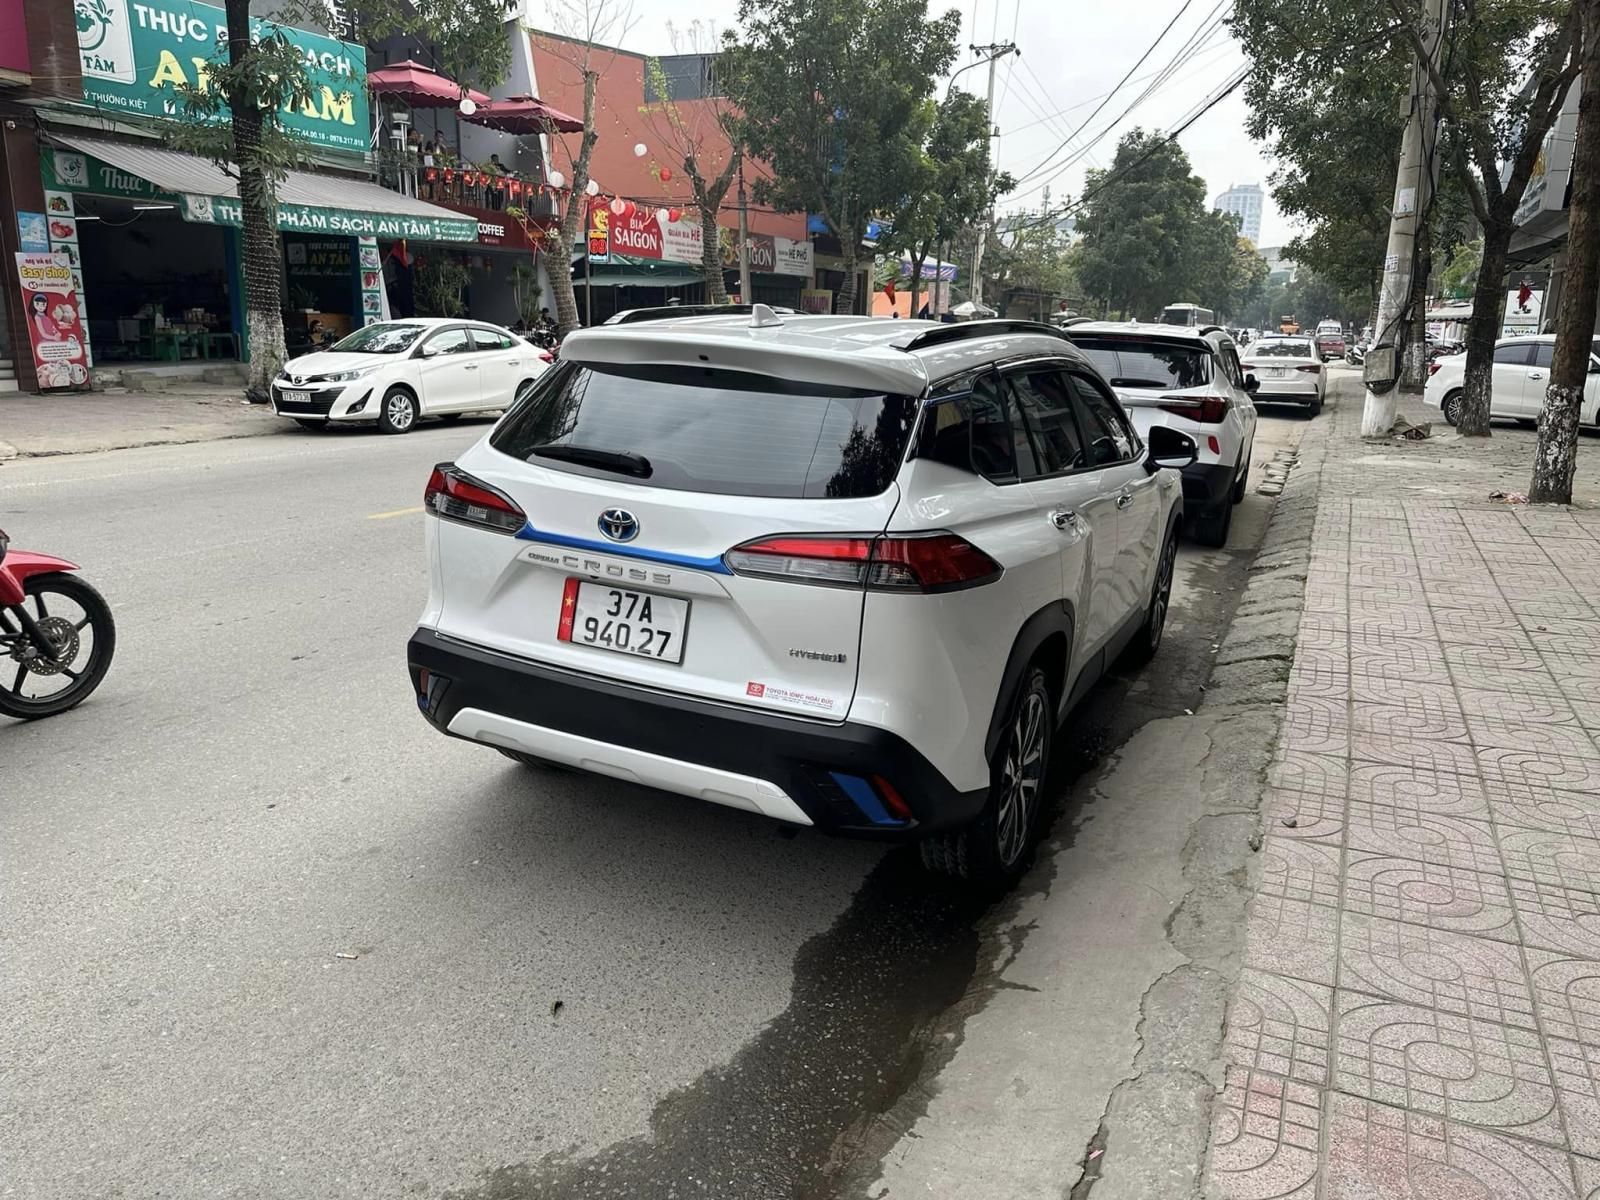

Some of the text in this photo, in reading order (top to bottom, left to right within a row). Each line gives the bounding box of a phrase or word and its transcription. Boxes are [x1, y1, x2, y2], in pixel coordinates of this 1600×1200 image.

[133, 3, 208, 42] THỰC
[82, 54, 116, 74] TÂM
[128, 97, 148, 110] KIỆT
[100, 166, 143, 195] Thực
[219, 206, 431, 236] TH PHẨM SẠCH AN TÂM
[477, 222, 505, 237] COFFEE
[615, 227, 657, 251] SAIGON
[735, 243, 773, 266] SIGON
[21, 265, 70, 280] Easy Shop
[562, 555, 671, 585] CROSS
[606, 590, 652, 623] 37A
[584, 616, 672, 657] 940.27
[766, 687, 788, 696] TOYOTA
